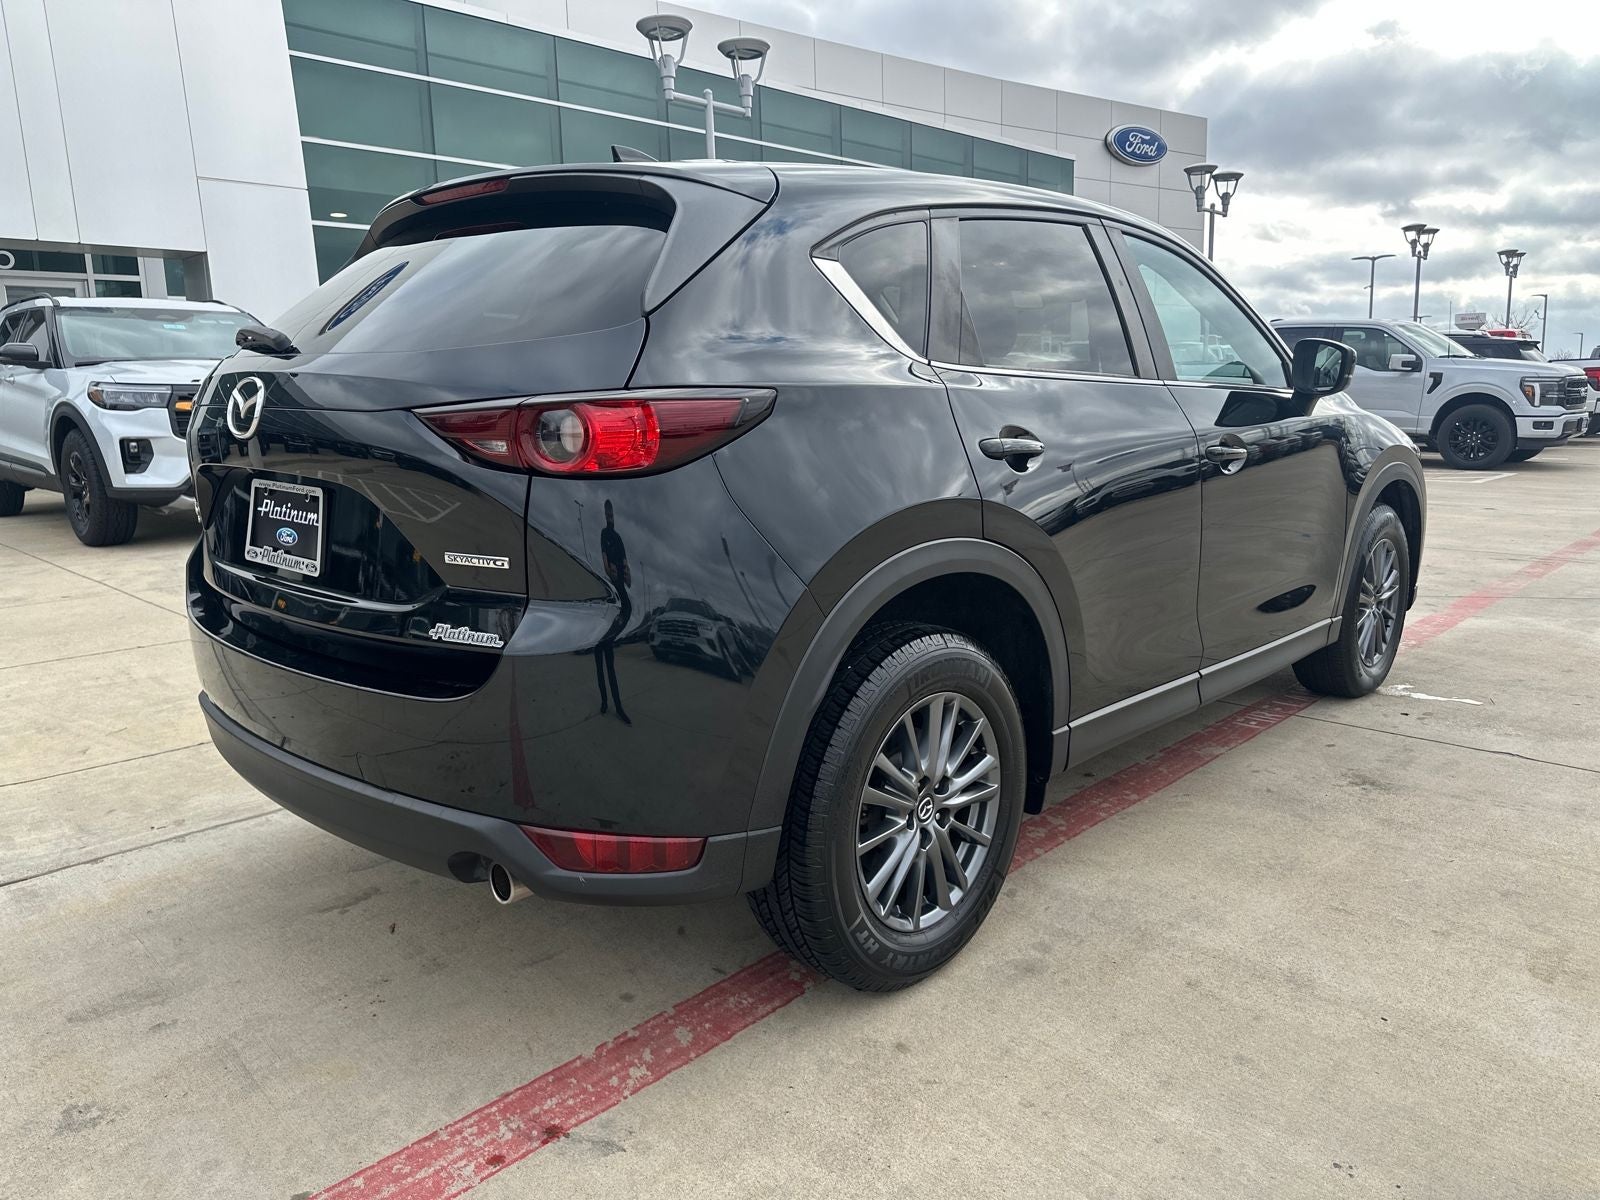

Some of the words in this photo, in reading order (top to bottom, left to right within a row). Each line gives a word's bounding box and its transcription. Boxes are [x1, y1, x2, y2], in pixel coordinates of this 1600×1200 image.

[1125, 132, 1158, 156] Ford
[258, 480, 317, 495] www.PlatinumFord.com
[257, 499, 320, 526] Platinum
[260, 546, 304, 571] Platinum
[447, 554, 491, 567] SKYACTIV
[429, 622, 504, 648] Platinum
